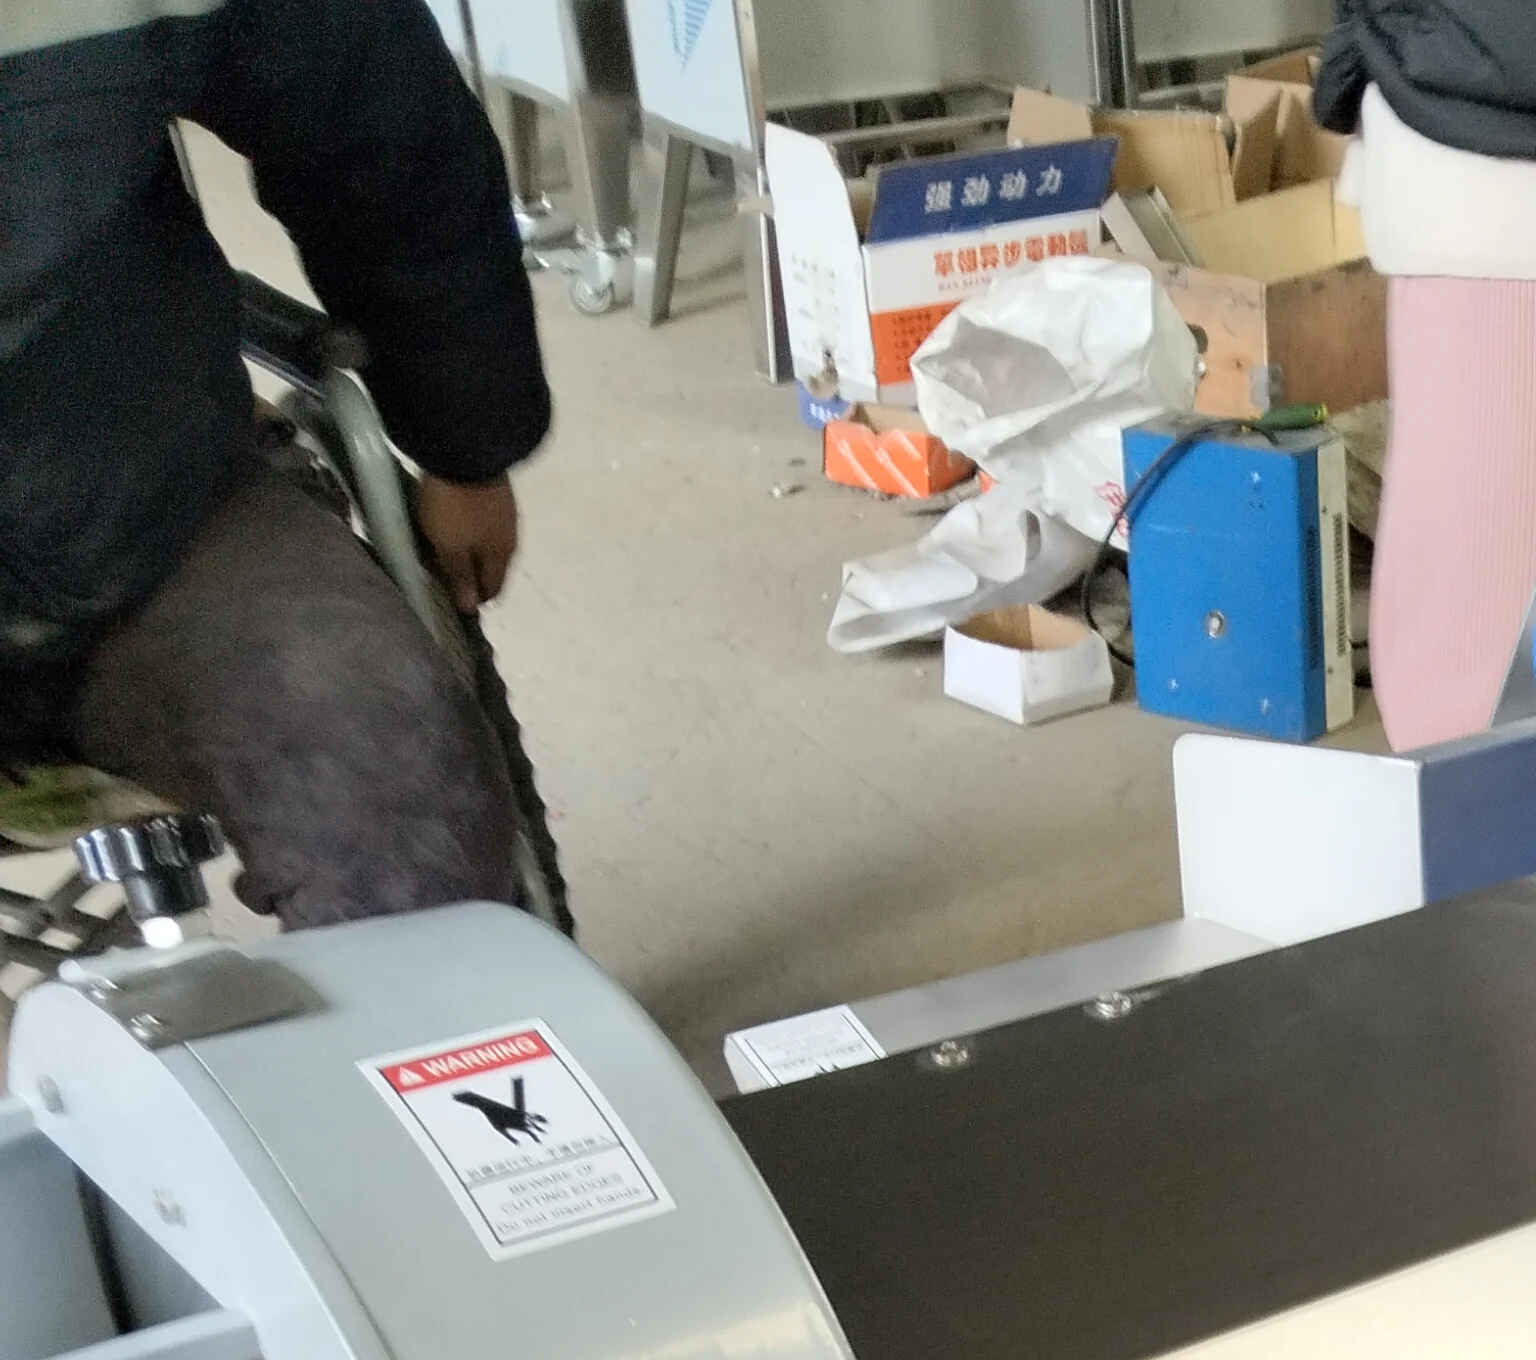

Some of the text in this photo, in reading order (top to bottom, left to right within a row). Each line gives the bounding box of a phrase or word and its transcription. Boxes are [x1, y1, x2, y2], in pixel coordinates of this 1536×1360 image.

[420, 1036, 540, 1078] WARNING
[500, 1172, 624, 1215] CUTTING EDGES
[508, 1162, 595, 1196] BEWARE OF
